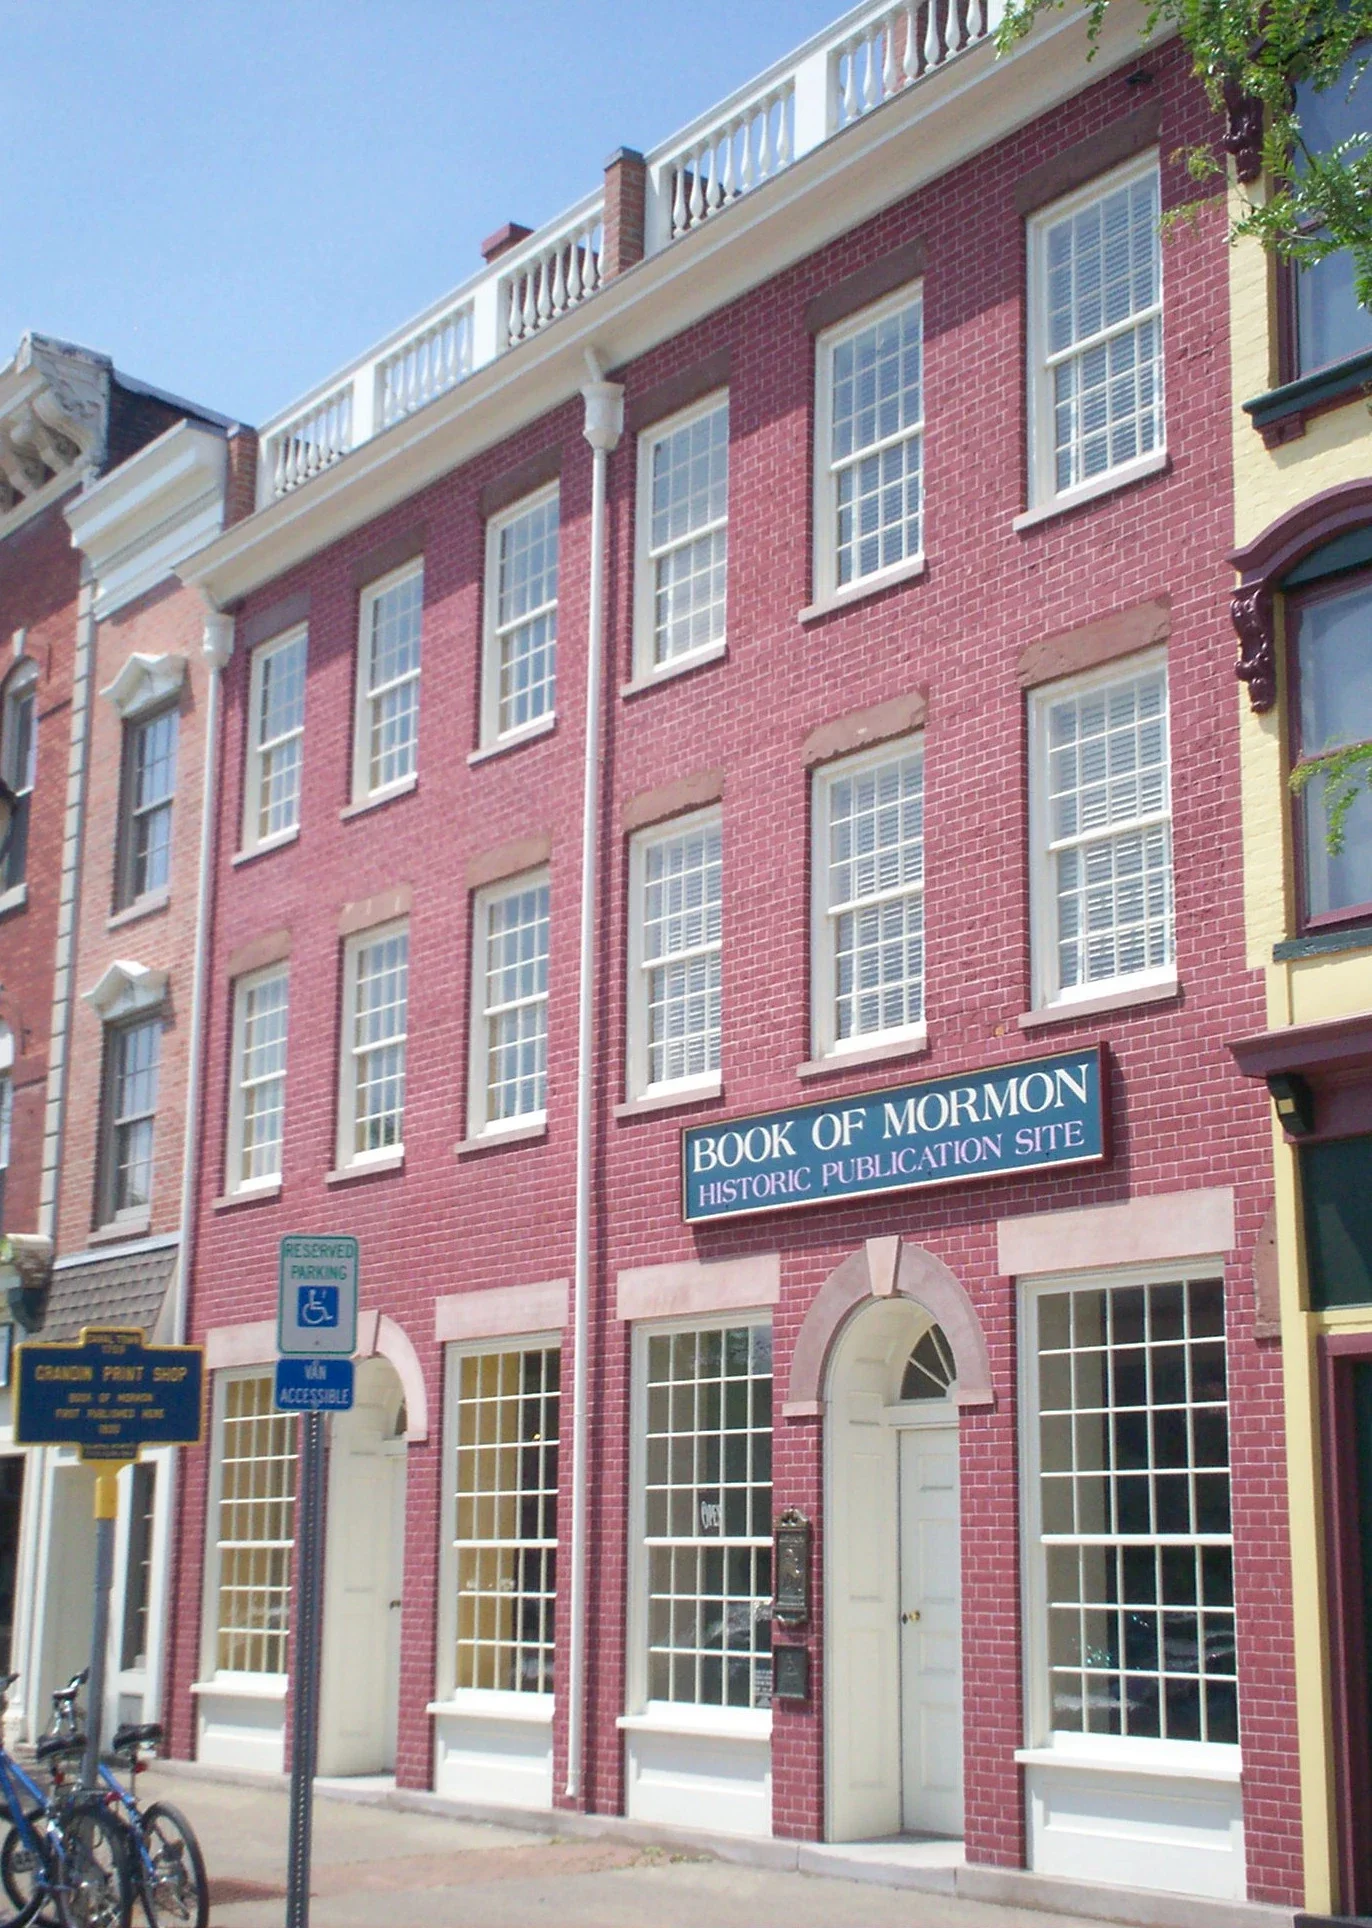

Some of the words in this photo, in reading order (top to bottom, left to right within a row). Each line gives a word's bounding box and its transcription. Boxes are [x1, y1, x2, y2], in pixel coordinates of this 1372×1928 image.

[693, 1121, 796, 1173] BOOK
[812, 1108, 866, 1150] OF
[883, 1065, 1089, 1138] MORMON
[699, 1167, 811, 1207] HISTORIC
[822, 1134, 1003, 1186] PUBLICATION
[1015, 1121, 1084, 1156] SITE
[285, 1244, 354, 1258] RESERVED
[291, 1265, 347, 1280] PARKING
[102, 1366, 144, 1381] PRINT
[153, 1367, 187, 1382] SHOP
[304, 1365, 327, 1380] VAN
[99, 1393, 110, 1402] OF
[280, 1389, 349, 1404] ACCESSIBLE
